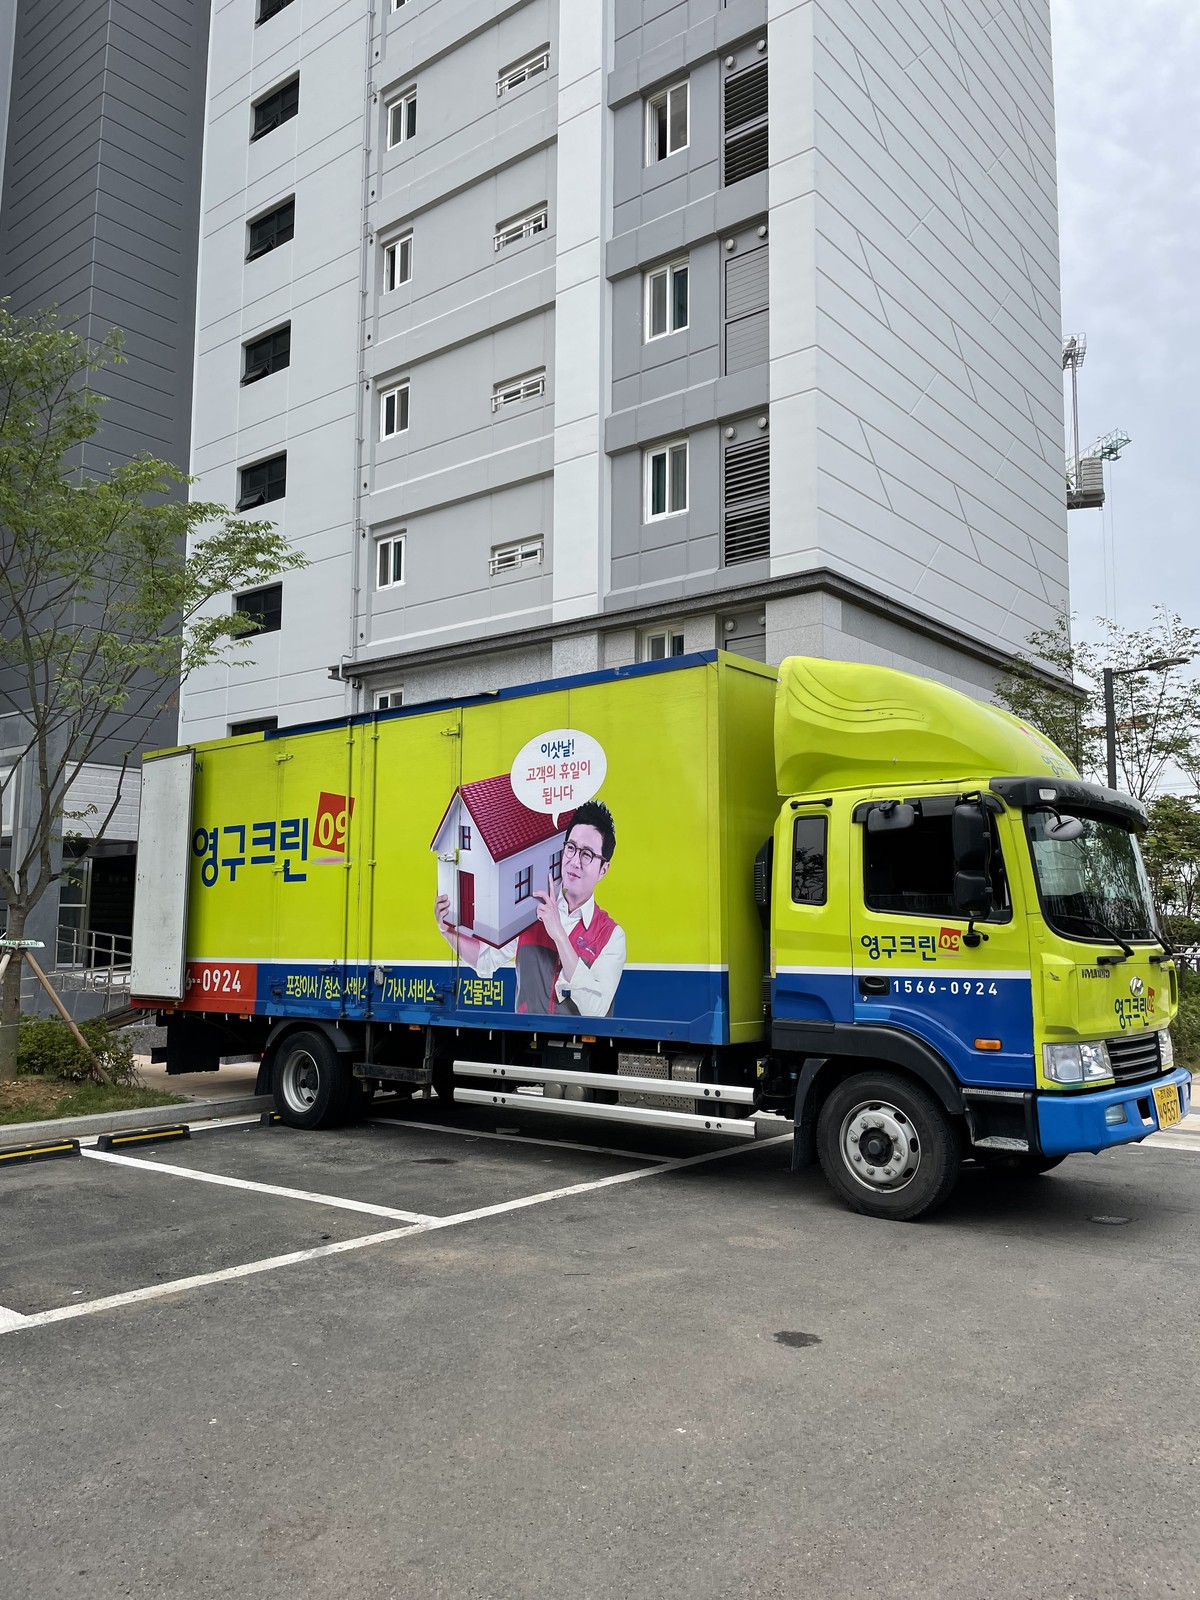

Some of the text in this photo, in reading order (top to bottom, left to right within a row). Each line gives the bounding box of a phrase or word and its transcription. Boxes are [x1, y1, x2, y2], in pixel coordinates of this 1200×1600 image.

[541, 739, 575, 759] 이삿날!
[526, 760, 591, 783] 고객의 휴일이
[542, 784, 574, 805] 됩니다
[192, 810, 352, 887] 영구크린 09
[861, 934, 960, 961] 영구크린 09
[408, 978, 435, 1003] 서비스
[893, 980, 998, 996] 1566-0924
[1115, 997, 1149, 1029] 영구크린
